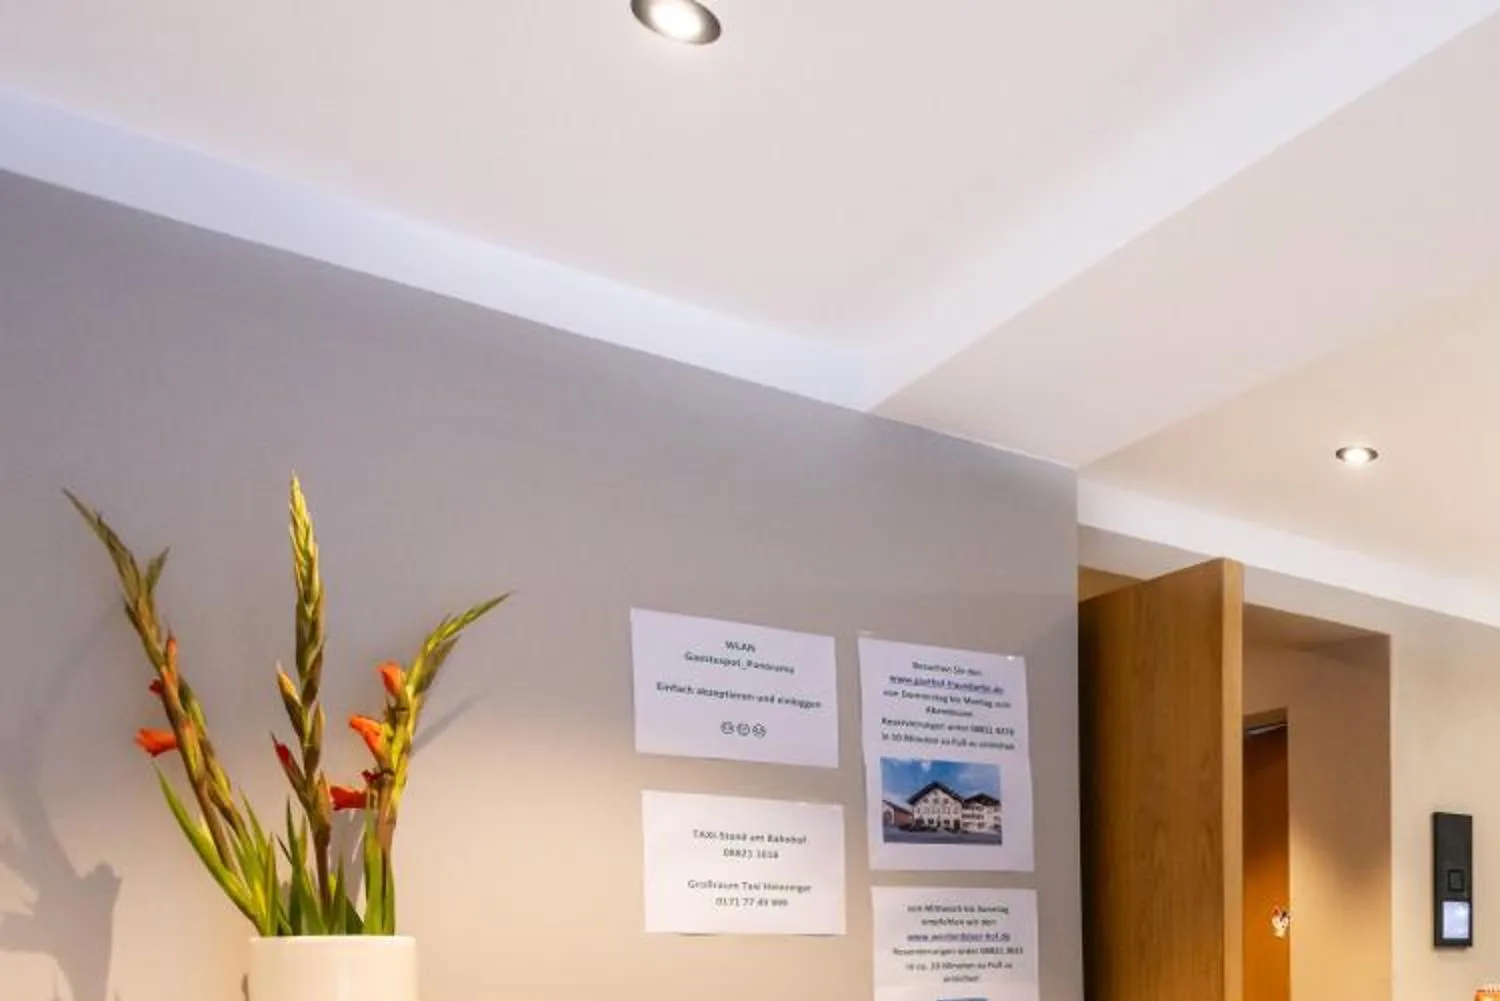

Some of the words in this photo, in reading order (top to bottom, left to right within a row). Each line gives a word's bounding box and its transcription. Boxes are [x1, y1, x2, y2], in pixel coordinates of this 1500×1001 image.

[725, 640, 756, 652] WLAN
[656, 681, 693, 695] Einfach
[697, 686, 754, 702] akzeptieren
[756, 694, 775, 705] und
[777, 695, 822, 709] einloggen
[741, 881, 761, 890] Taxi
